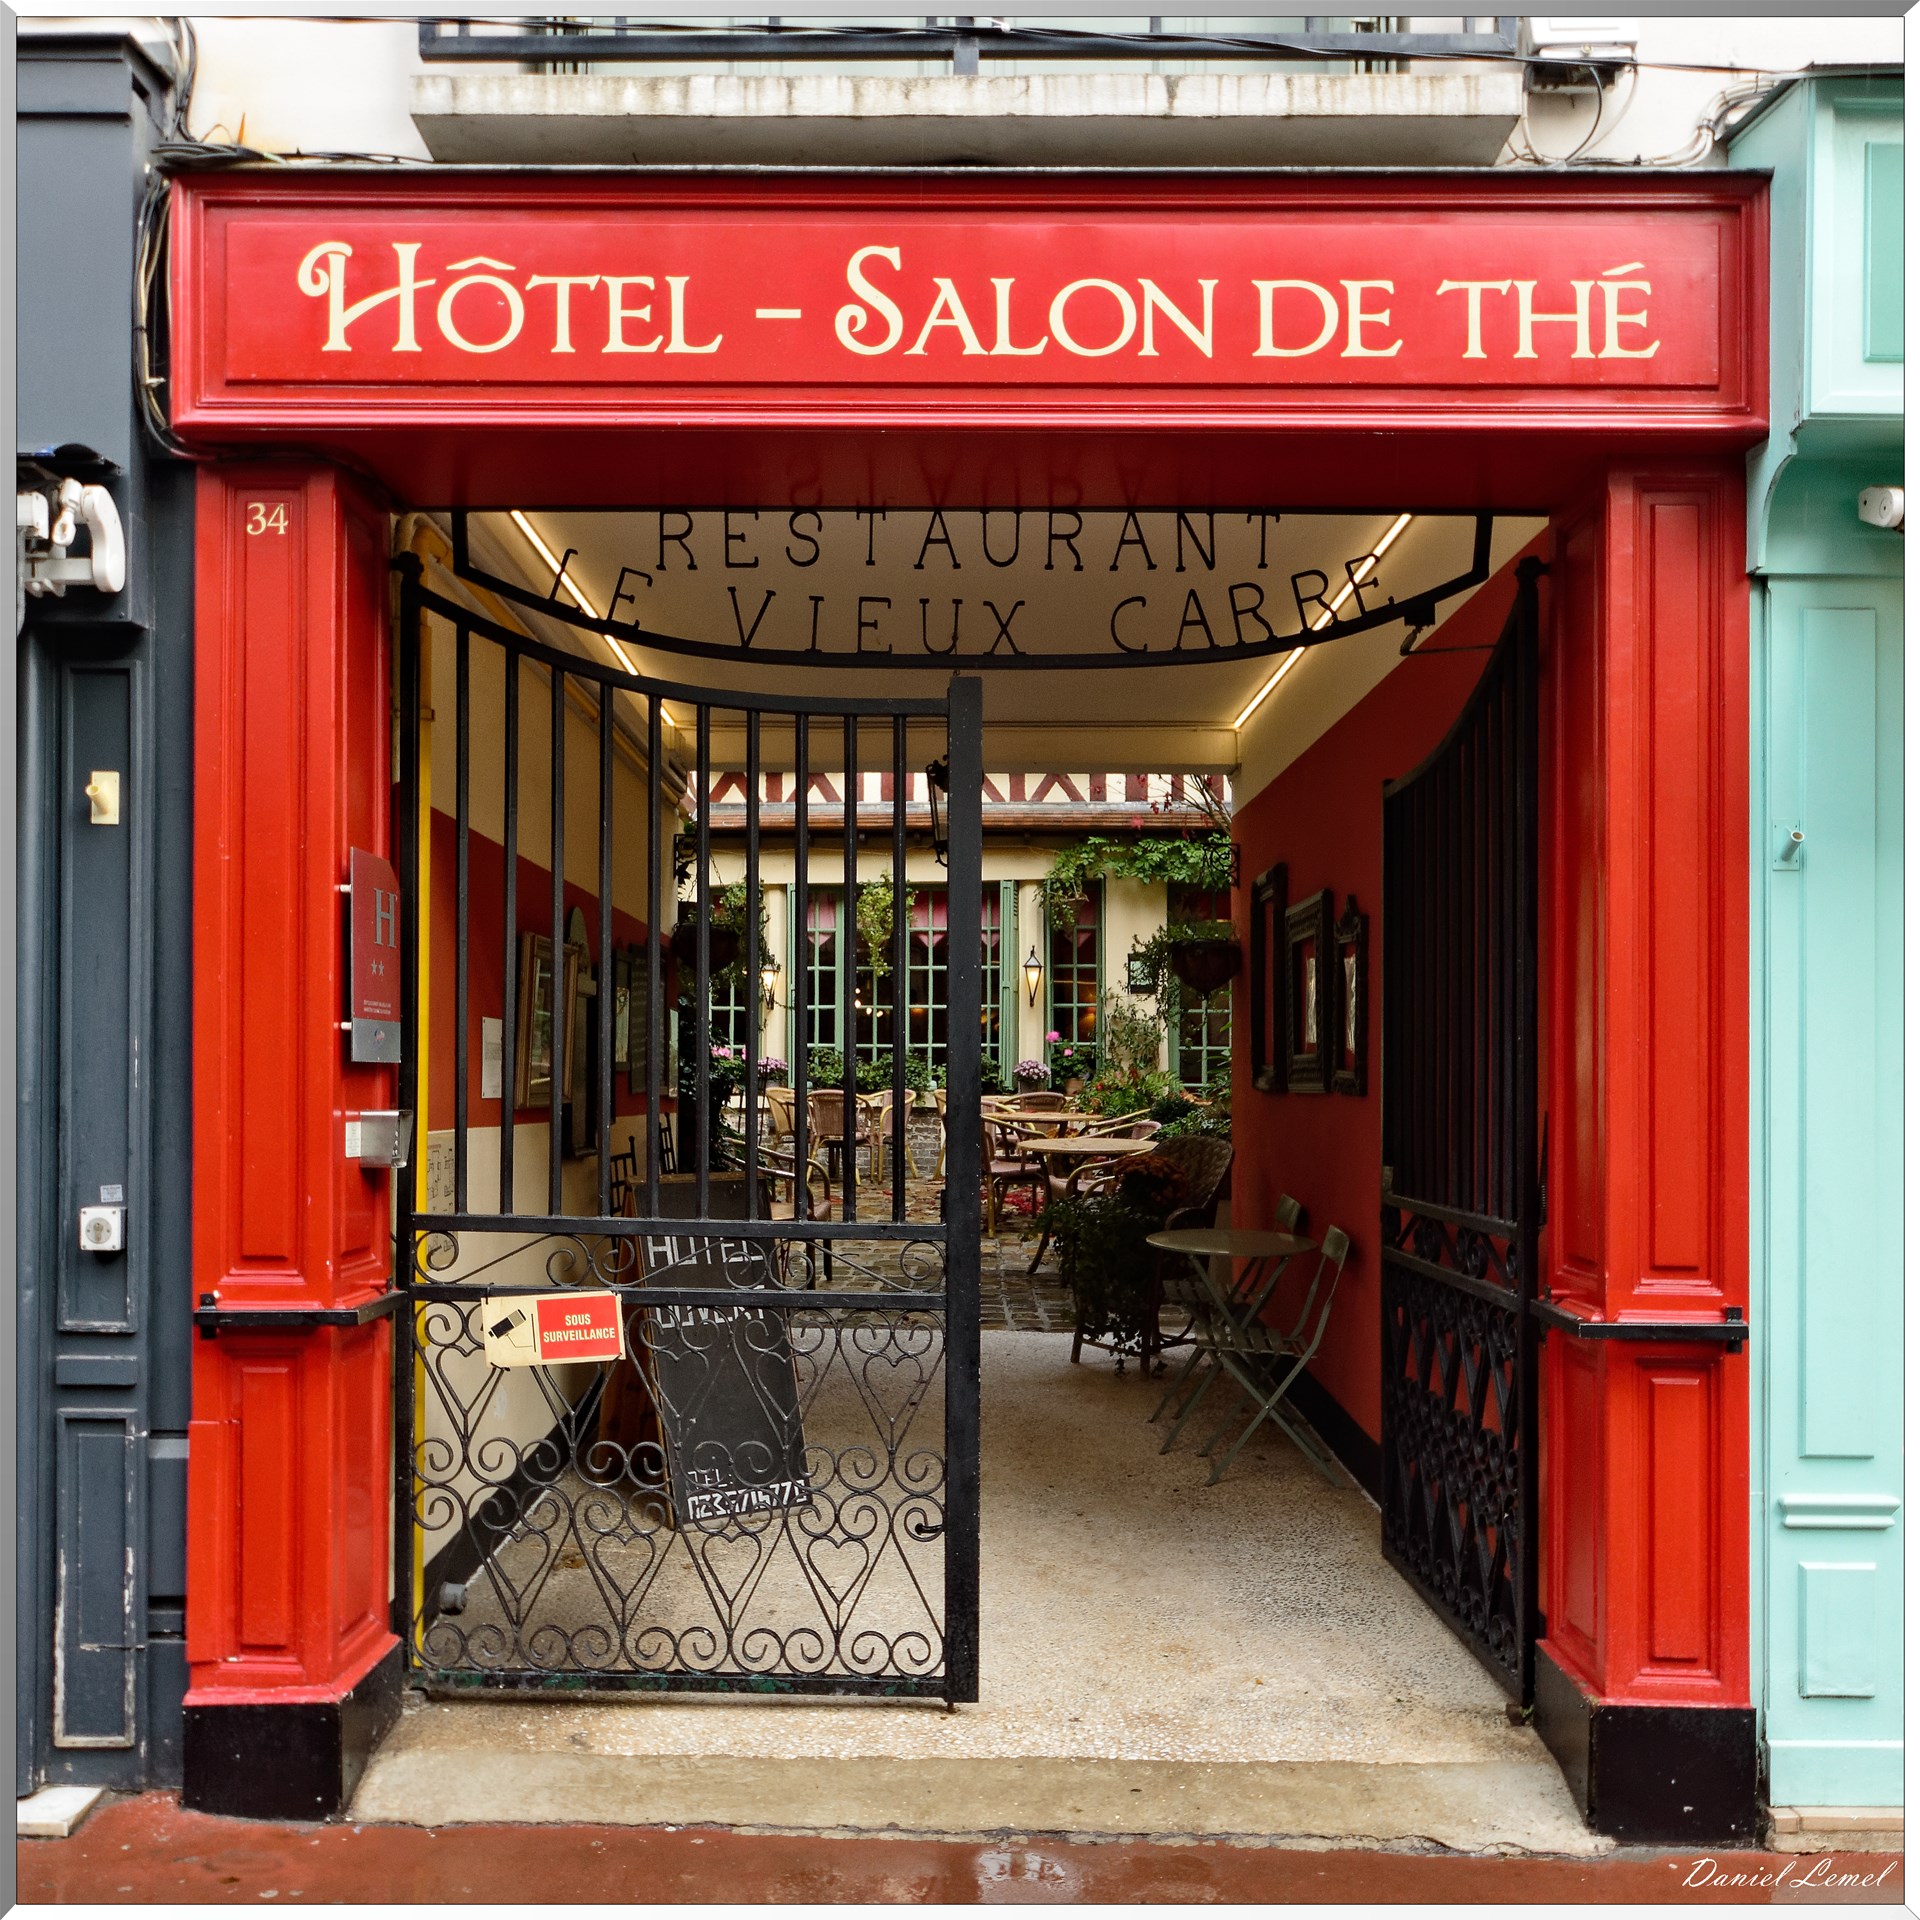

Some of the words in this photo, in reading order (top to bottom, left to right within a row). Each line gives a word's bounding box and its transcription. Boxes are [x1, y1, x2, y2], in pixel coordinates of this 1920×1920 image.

[298, 241, 723, 354] HÔTEL
[834, 245, 1219, 358] SALON
[1252, 280, 1403, 358] DE
[1436, 262, 1661, 359] THÉ
[247, 502, 289, 535] 34
[656, 509, 1281, 573] RESTAURANT
[549, 548, 652, 632] LE
[727, 586, 1026, 656] VIEUX
[373, 888, 398, 948] H
[543, 1327, 616, 1343] SURVEILLANCE
[565, 1313, 592, 1327] SOUS
